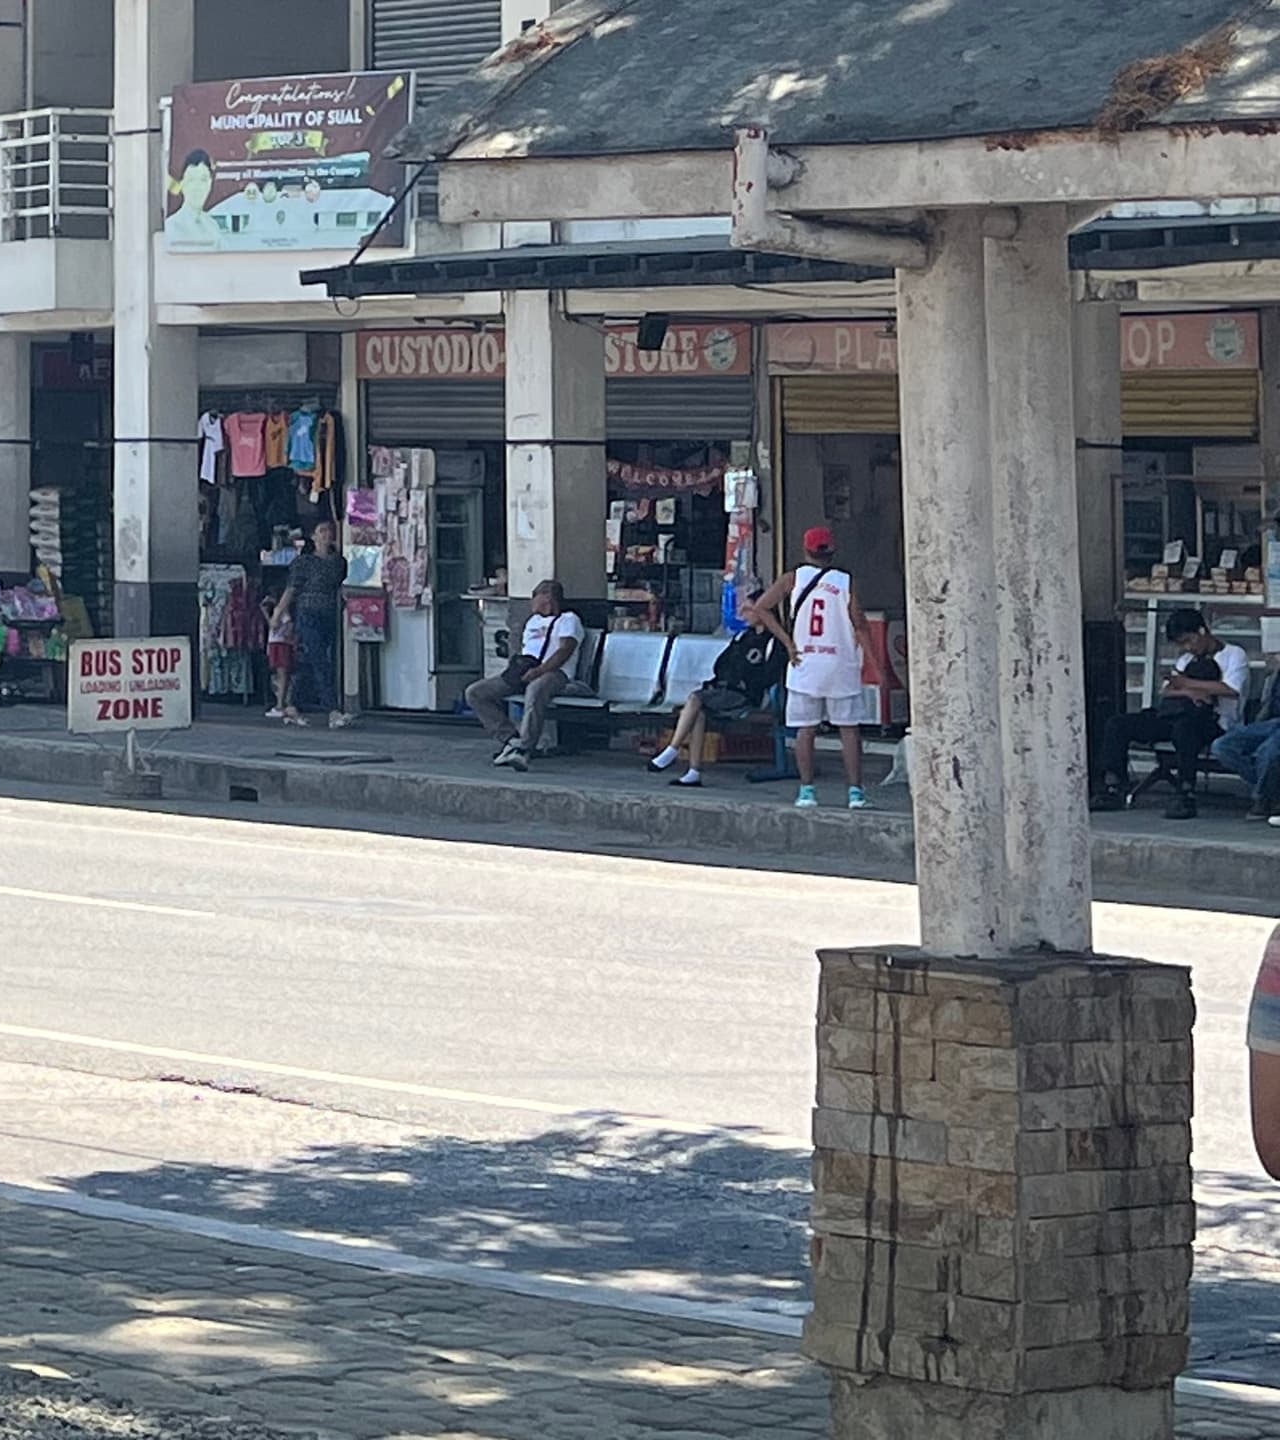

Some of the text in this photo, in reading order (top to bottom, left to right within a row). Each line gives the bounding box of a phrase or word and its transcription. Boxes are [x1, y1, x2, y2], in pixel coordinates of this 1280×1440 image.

[211, 109, 361, 130] MUNICIPALITY OF SUAL
[809, 599, 825, 637] 6
[82, 648, 180, 676] BUS STOP
[81, 680, 120, 693] LOADING
[131, 679, 179, 692] UNLOADING
[98, 698, 162, 720] ZONE
